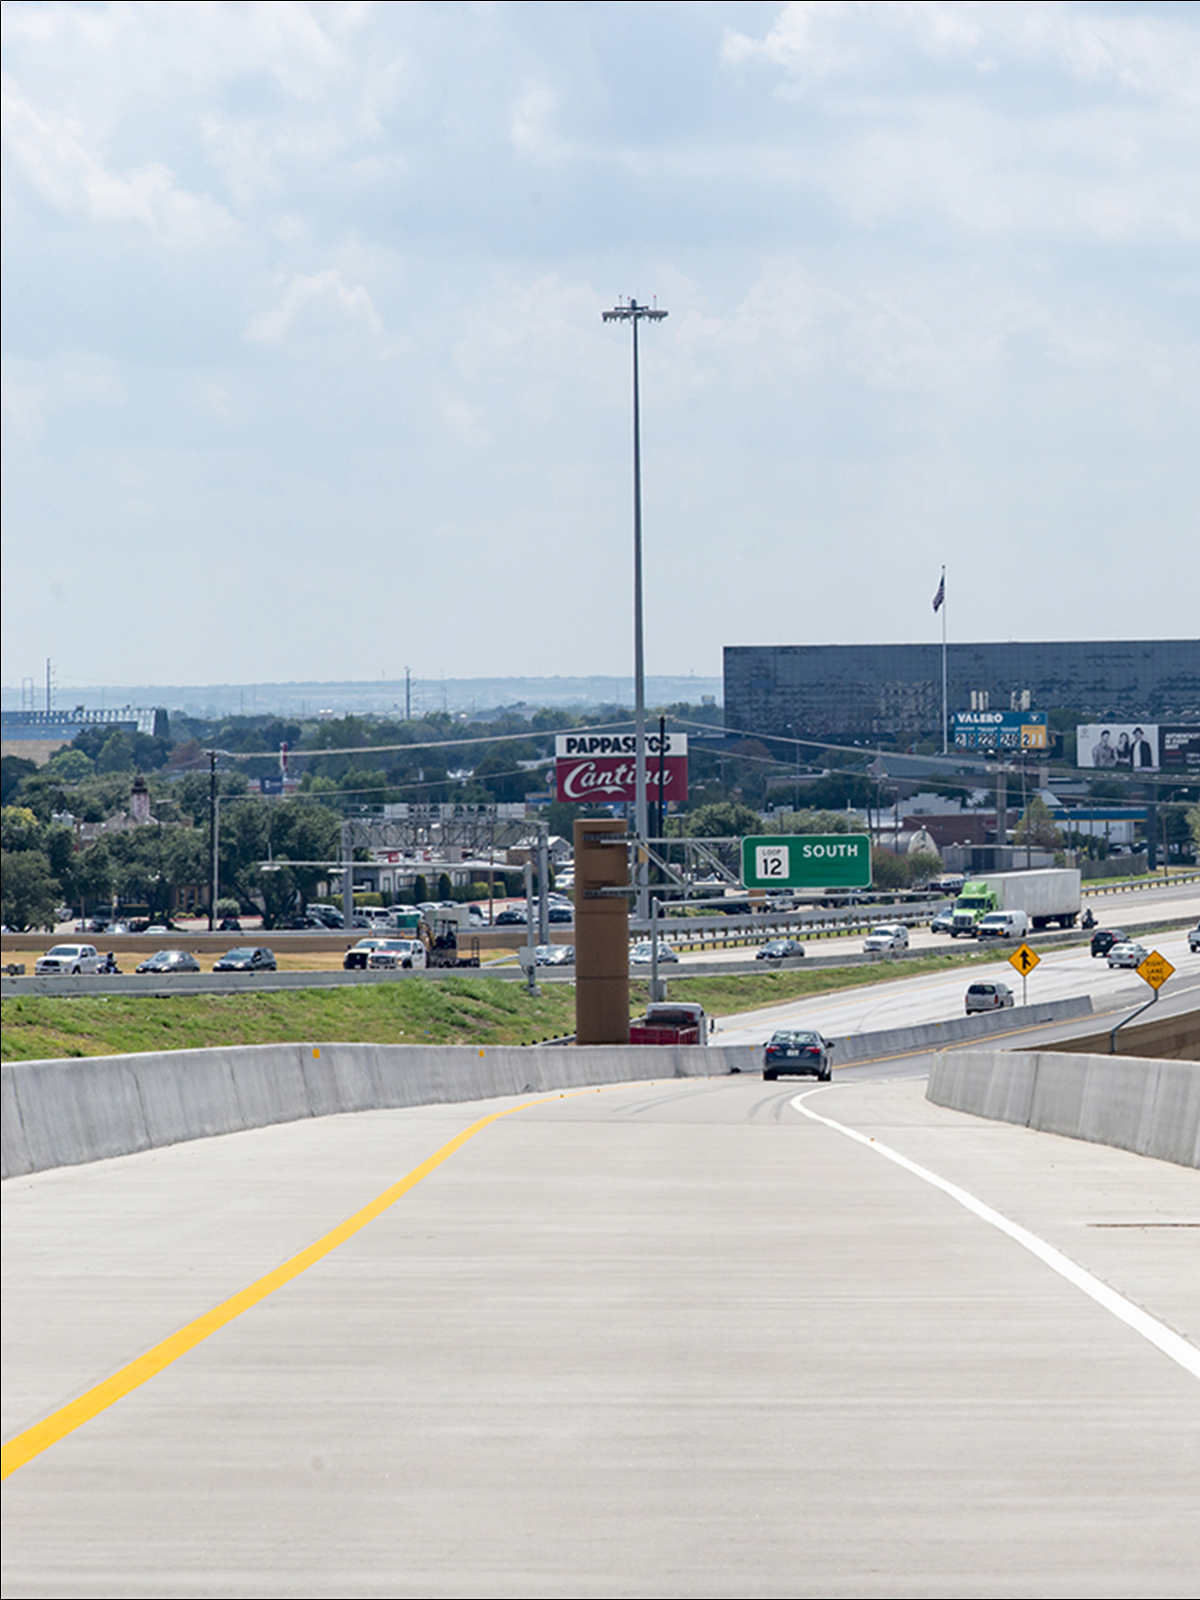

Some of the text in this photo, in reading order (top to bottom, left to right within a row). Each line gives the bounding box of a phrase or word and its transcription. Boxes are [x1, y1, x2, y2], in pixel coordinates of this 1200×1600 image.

[957, 713, 1004, 724] VALERO
[566, 736, 671, 754] PAPPASIOS
[762, 848, 783, 856] LOOP
[803, 844, 858, 857] SOUTH
[763, 858, 782, 875] 12
